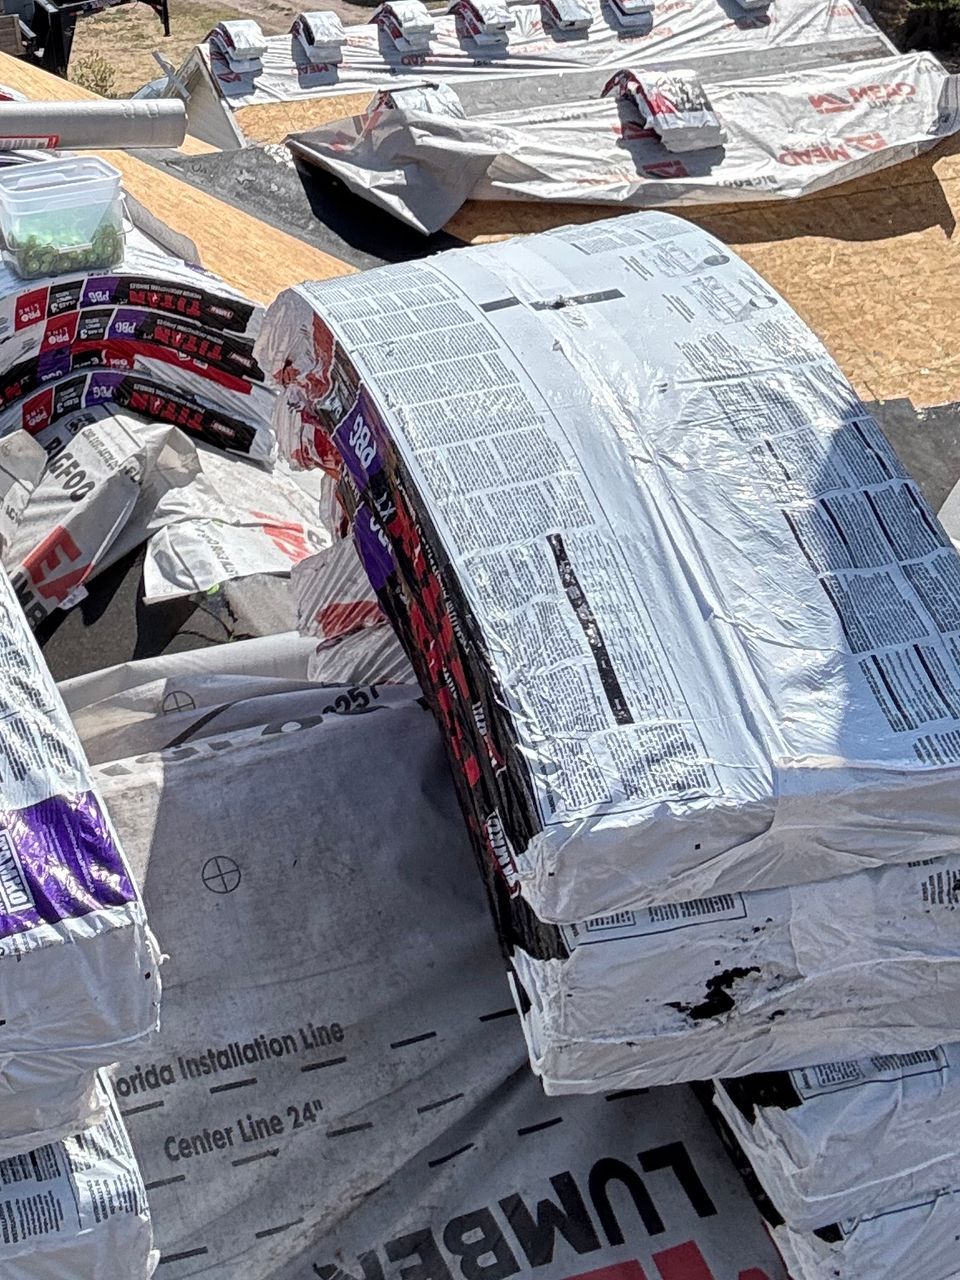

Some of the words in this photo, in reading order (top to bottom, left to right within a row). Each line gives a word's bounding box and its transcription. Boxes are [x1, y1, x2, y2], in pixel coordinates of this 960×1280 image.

[847, 82, 917, 103] MEAD
[778, 146, 852, 167] MEAD
[88, 290, 110, 303] PBG
[129, 290, 201, 317] TITAN
[21, 309, 41, 322] PRO
[80, 329, 88, 339] 3
[115, 322, 137, 334] PBG
[48, 333, 70, 345] PRO
[154, 325, 222, 360] TITAN
[28, 410, 48, 426] PRO
[130, 391, 204, 431] TITAN
[349, 413, 377, 470] PBG
[112, 1064, 176, 1098] orida
[177, 1034, 298, 1080] Installation
[298, 1022, 346, 1051] Line
[164, 1125, 235, 1161] Center
[237, 1114, 285, 1143] Line
[287, 1099, 323, 1130] 24"
